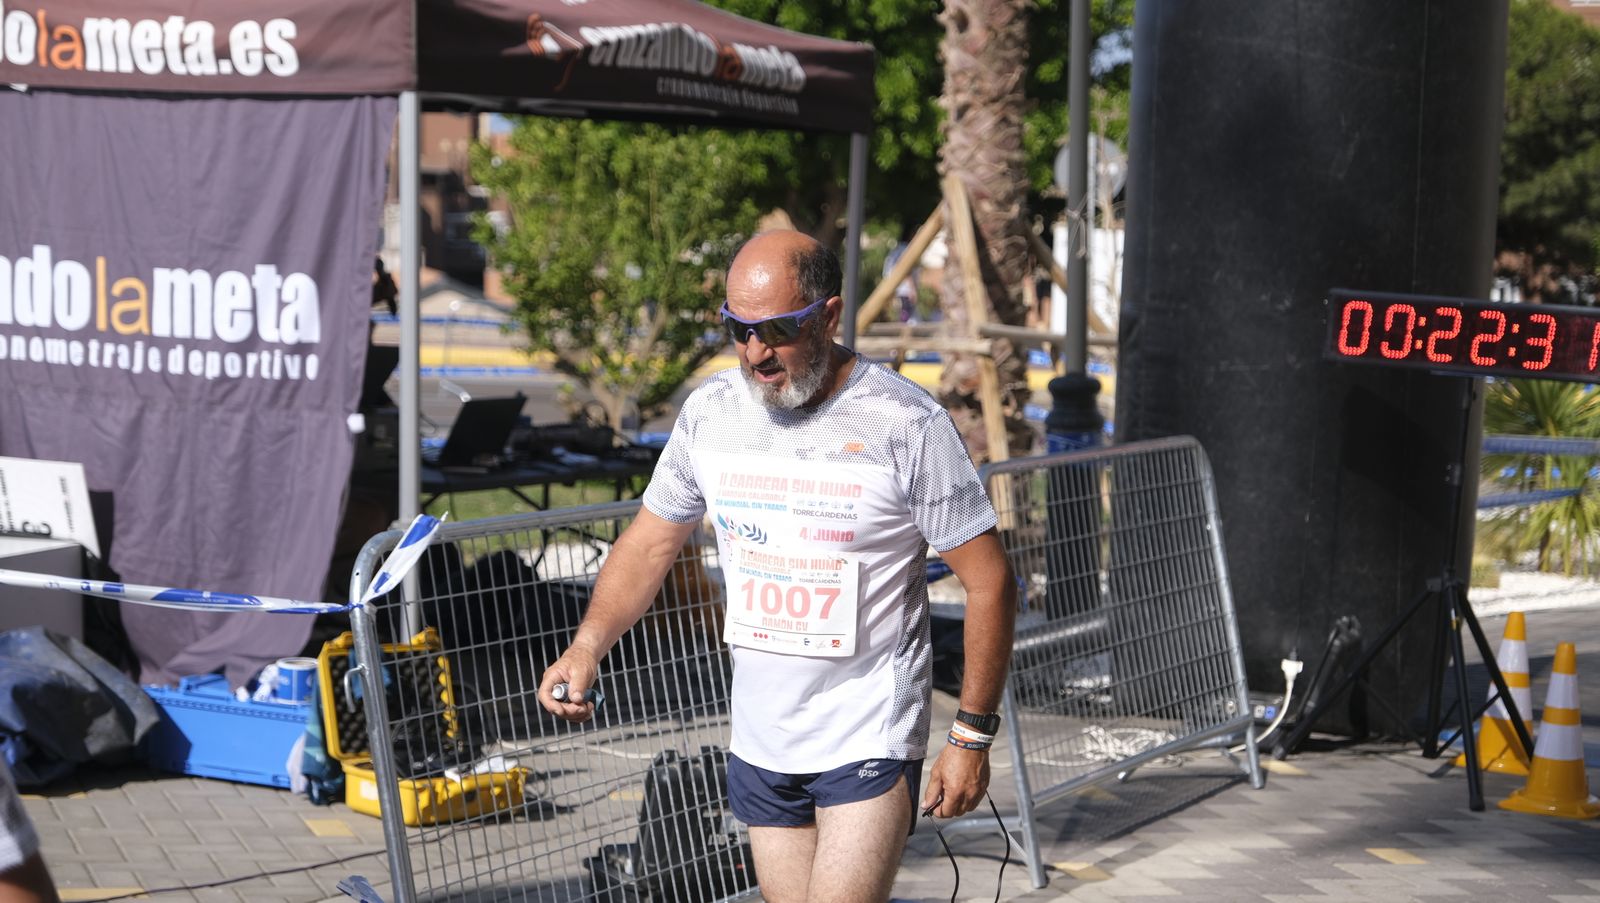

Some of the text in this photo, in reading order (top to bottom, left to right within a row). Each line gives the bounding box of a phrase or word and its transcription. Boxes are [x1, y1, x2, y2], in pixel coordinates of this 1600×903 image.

[0, 0, 299, 76] olameta.es
[168, 344, 319, 381] deportivo
[730, 473, 789, 493] CARRERA
[791, 478, 817, 494] SIN
[819, 482, 863, 498] HUMO
[800, 527, 855, 543] 4 JUNIO
[789, 557, 808, 569] SIN
[740, 578, 841, 620] 1007
